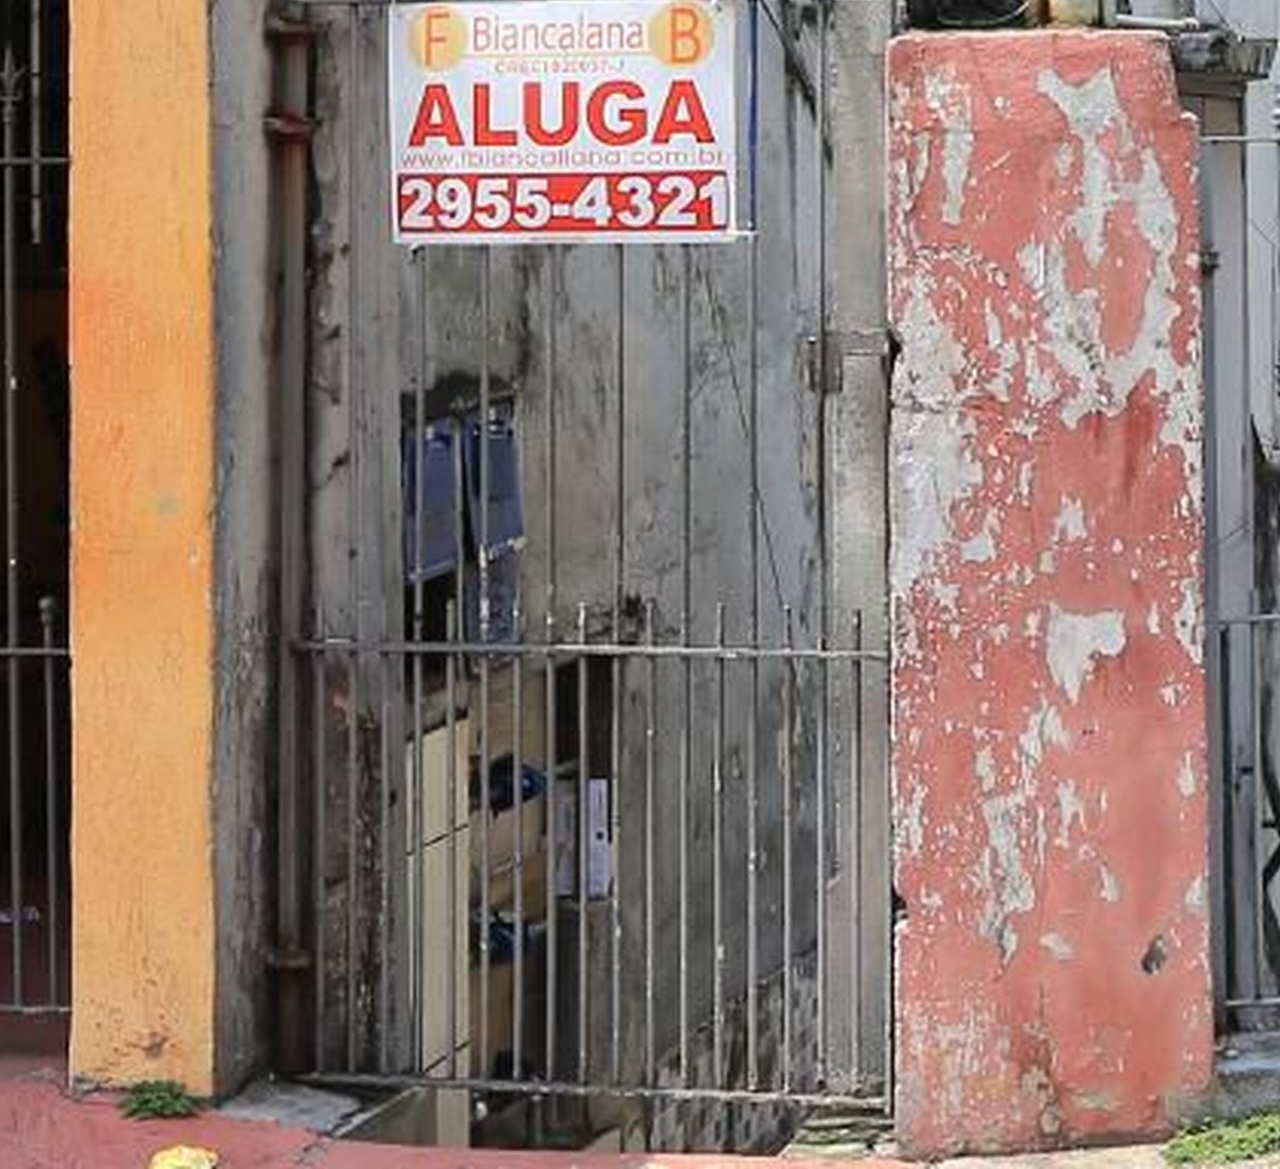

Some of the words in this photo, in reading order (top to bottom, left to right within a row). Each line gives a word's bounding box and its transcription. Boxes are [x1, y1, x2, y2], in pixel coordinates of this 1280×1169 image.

[424, 11, 451, 68] F
[669, 7, 703, 65] B
[408, 80, 716, 147] ALUGA
[399, 175, 728, 229] 2955-4321
